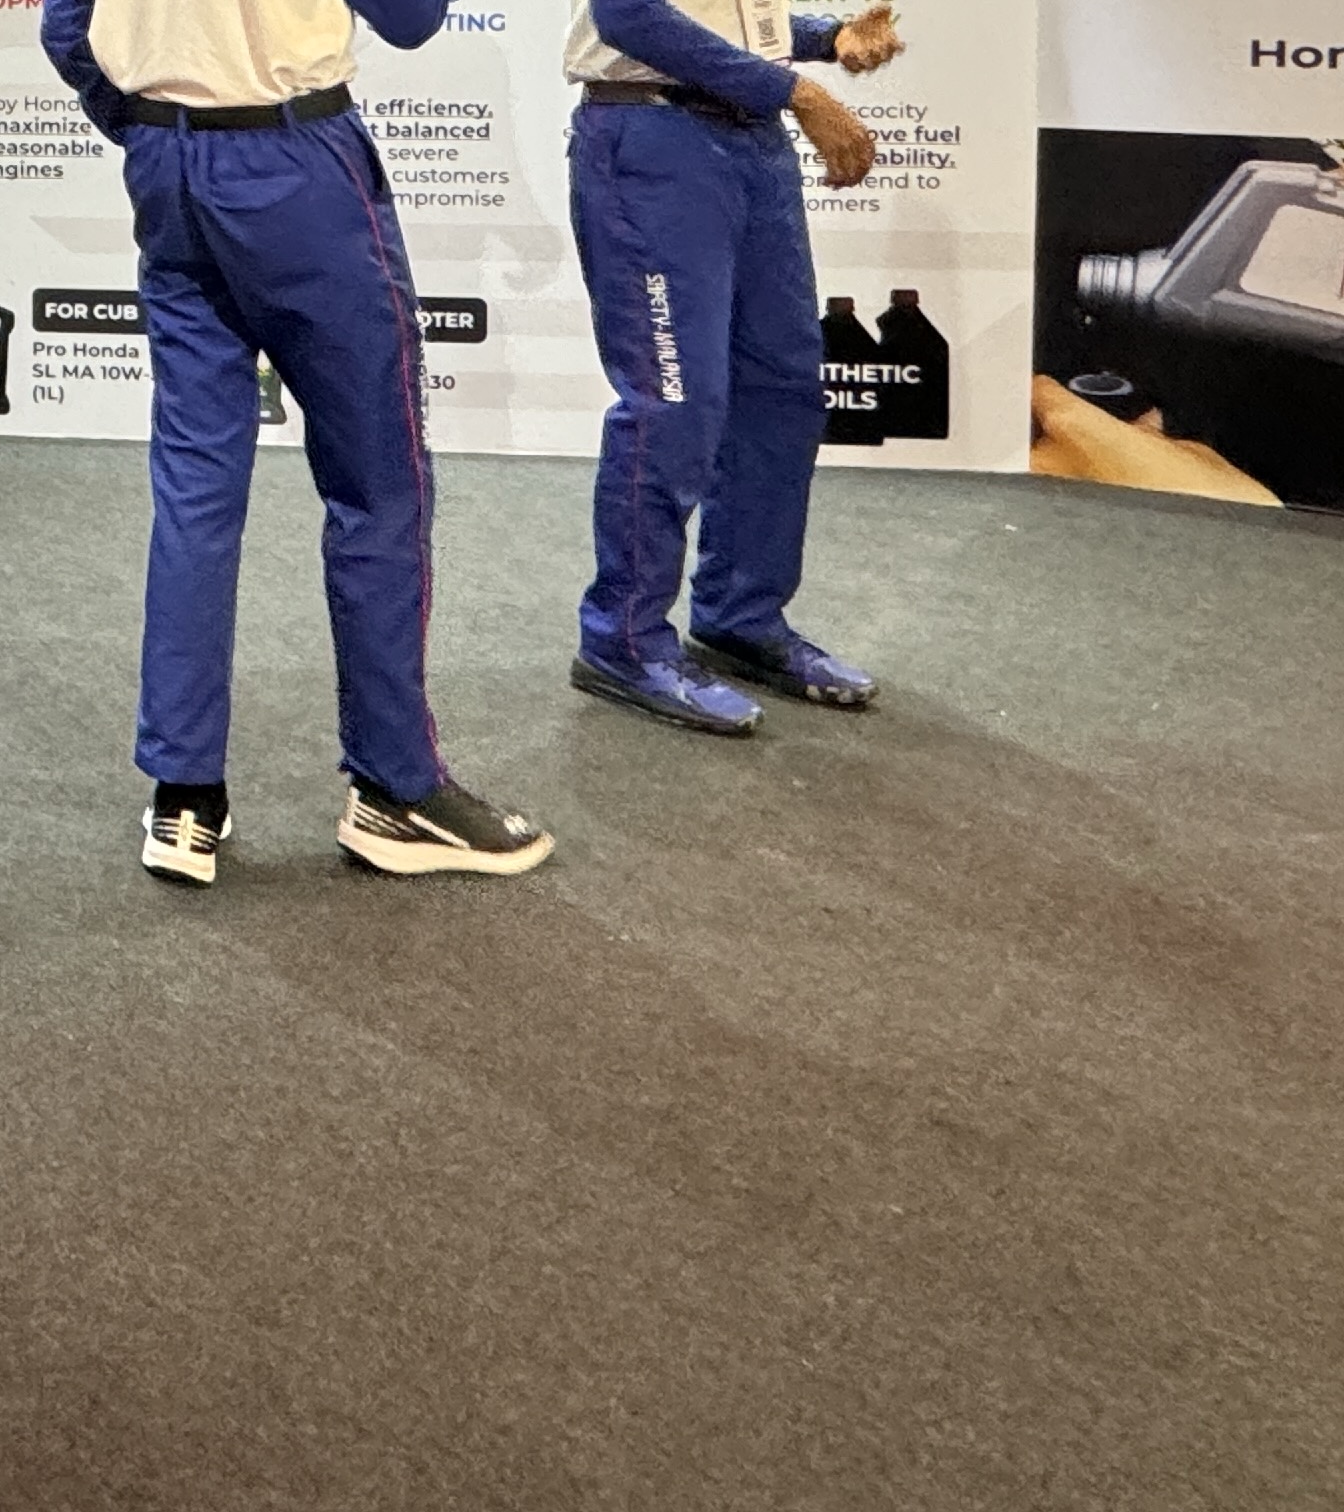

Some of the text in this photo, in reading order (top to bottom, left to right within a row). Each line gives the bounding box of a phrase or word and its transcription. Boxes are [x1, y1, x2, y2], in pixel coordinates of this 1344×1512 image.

[1250, 38, 1344, 70] Hon
[374, 97, 494, 119] efficiency,
[386, 121, 491, 139] balanced
[914, 125, 961, 142] fuel
[387, 148, 460, 161] severe
[392, 168, 510, 184] customers
[916, 174, 941, 190] to
[393, 190, 506, 209] mpromise
[45, 301, 140, 322] FOR CUB
[32, 342, 140, 359] Pro Honda
[32, 363, 154, 381] SL MA 10W-
[819, 362, 922, 384] THETIC
[428, 374, 456, 391] 30
[32, 384, 64, 405] (1L)
